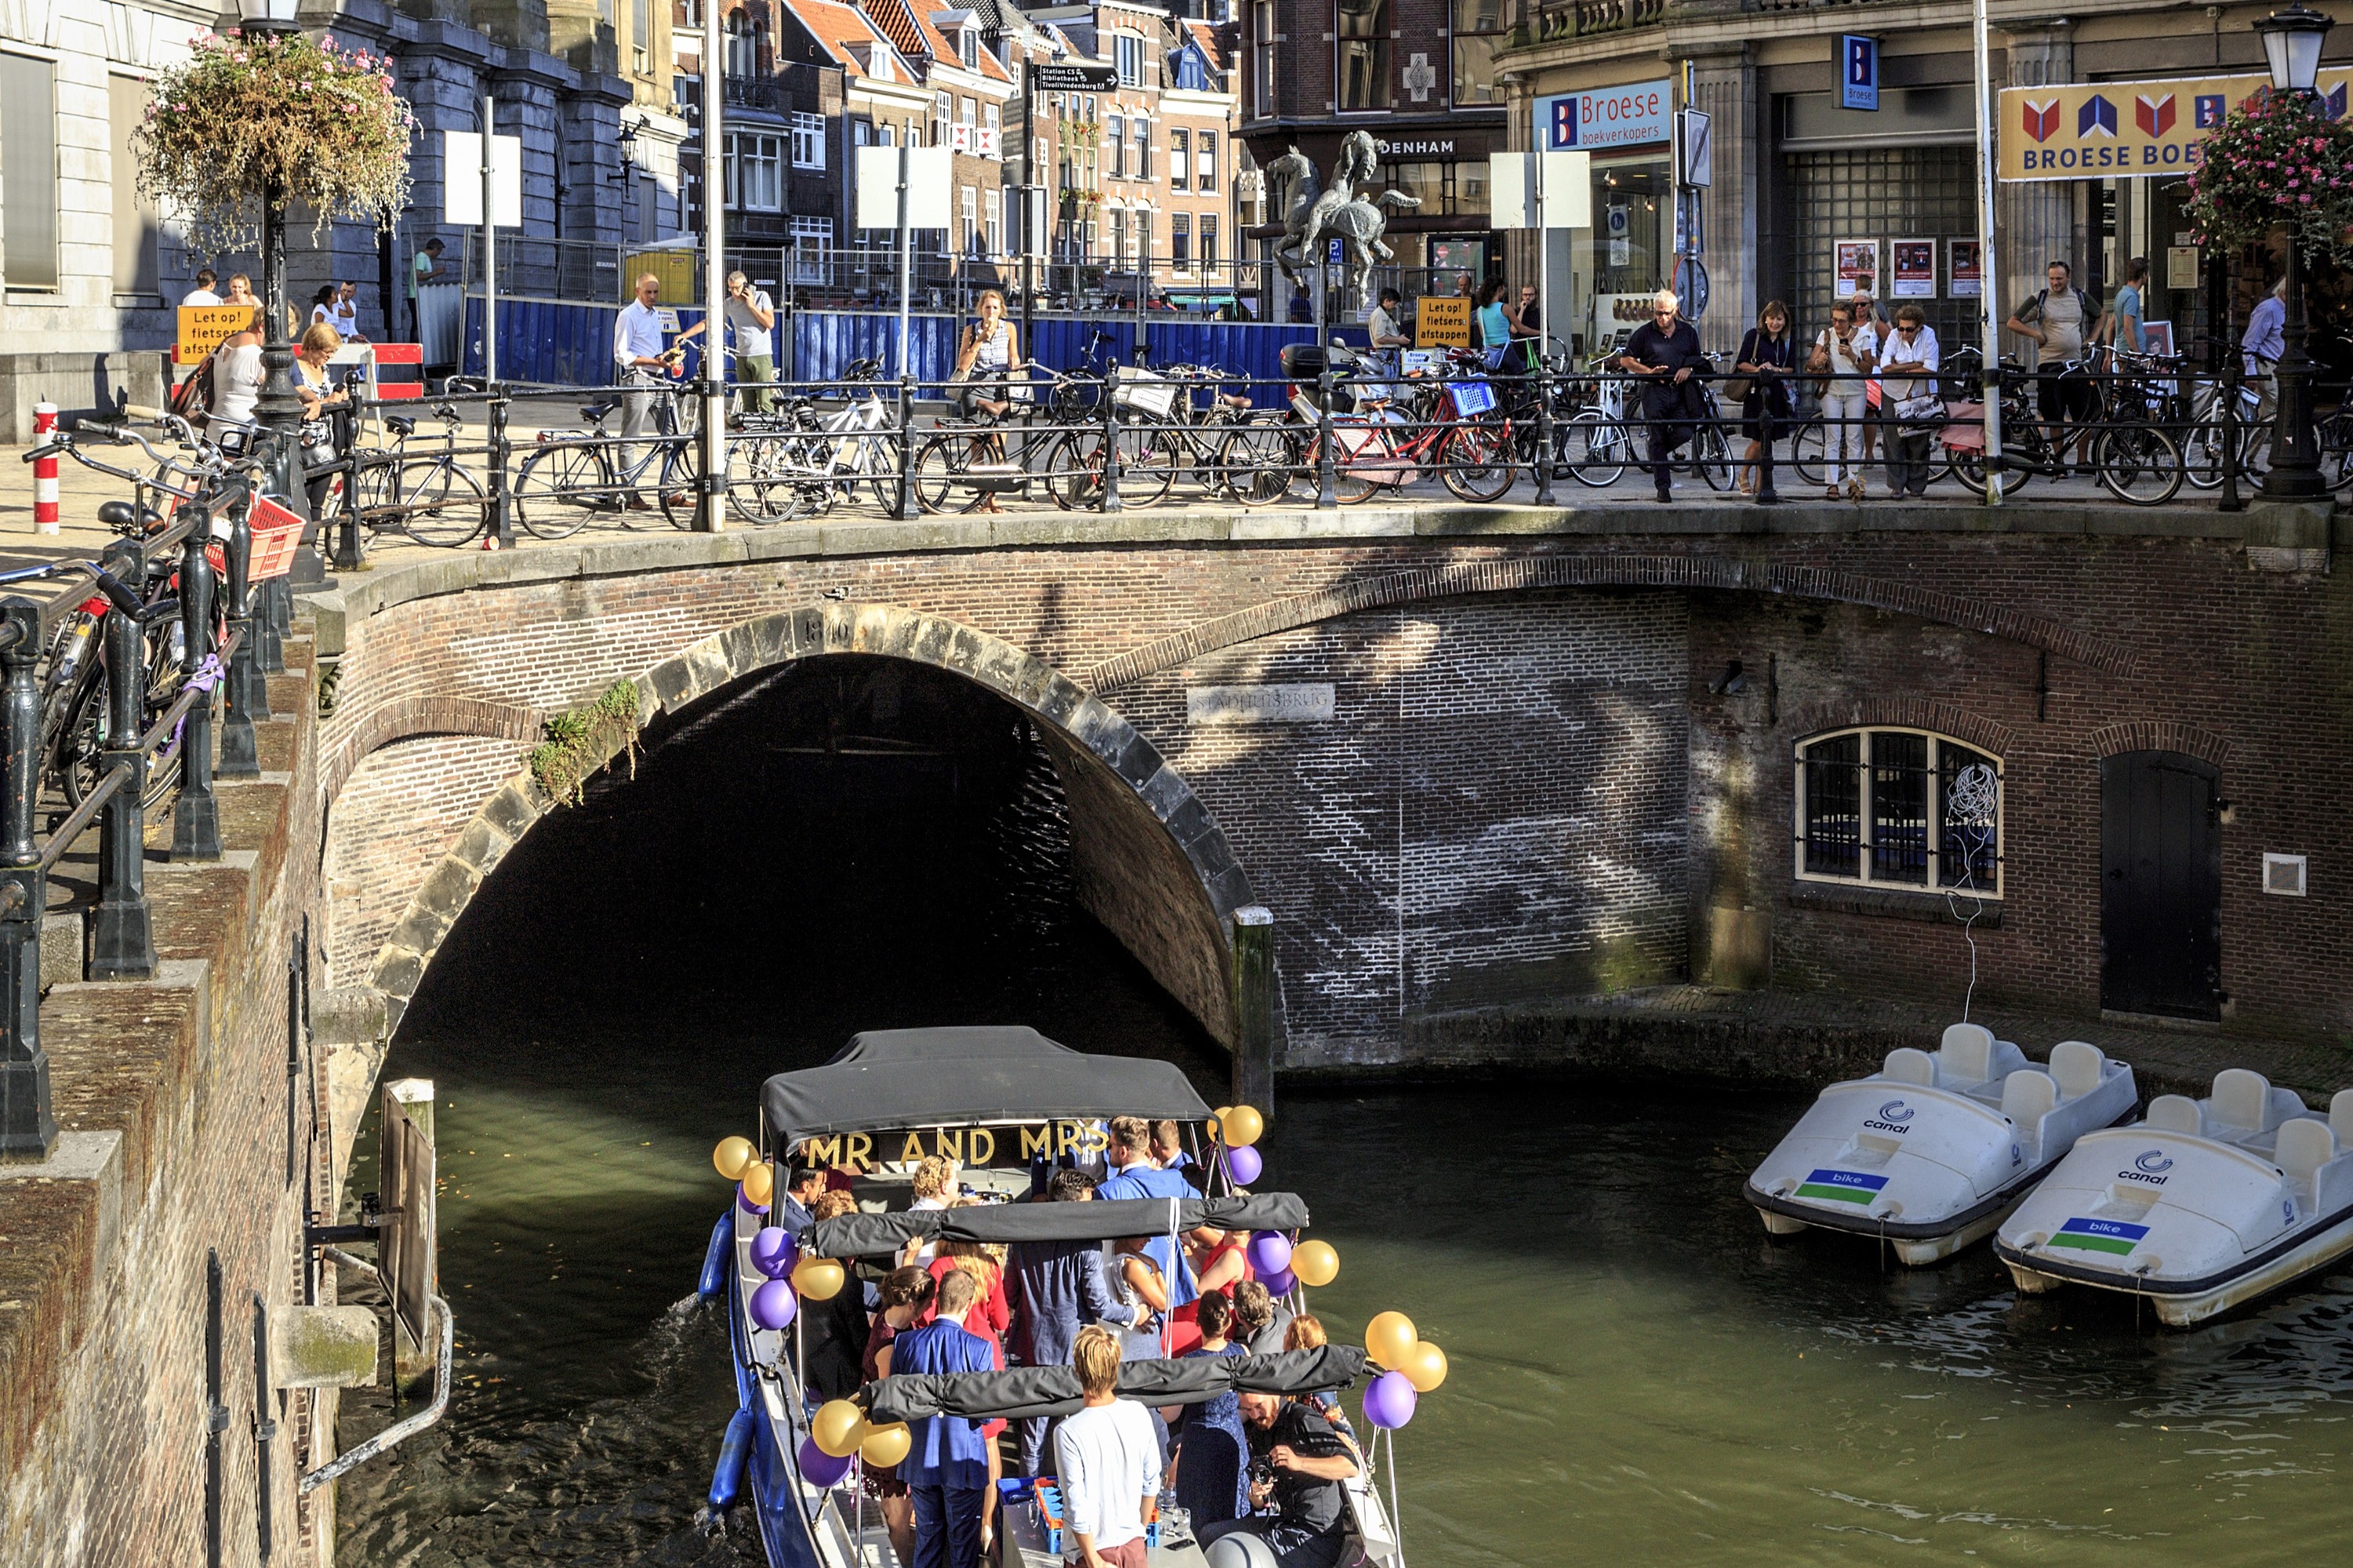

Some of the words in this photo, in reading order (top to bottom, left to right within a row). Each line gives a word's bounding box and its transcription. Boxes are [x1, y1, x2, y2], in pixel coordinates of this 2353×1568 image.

[1042, 82, 1096, 90] TivoliVredenburg
[1849, 88, 1872, 100] Broese
[1582, 93, 1659, 125] Broese
[1582, 126, 1659, 145] boekverkopers
[1380, 141, 1453, 155] DENHAM
[2024, 147, 2130, 169] BROESE
[2143, 144, 2209, 166] BOE
[1329, 241, 1338, 254] P
[1429, 303, 1444, 312] Let
[1447, 303, 1461, 313] op!
[195, 312, 216, 323] Let
[221, 311, 241, 324] op!
[1427, 316, 1462, 326] fietsers
[1420, 329, 1467, 340] afstappen
[1196, 693, 1328, 710] STADHUISBRUG
[1864, 1119, 1910, 1134] canal
[808, 1131, 873, 1170] MR
[900, 1128, 995, 1166] AND
[1020, 1119, 1109, 1161] MRS
[1832, 1173, 1862, 1184] bike
[2118, 1170, 2169, 1185] canal
[2089, 1222, 2121, 1233] bike
